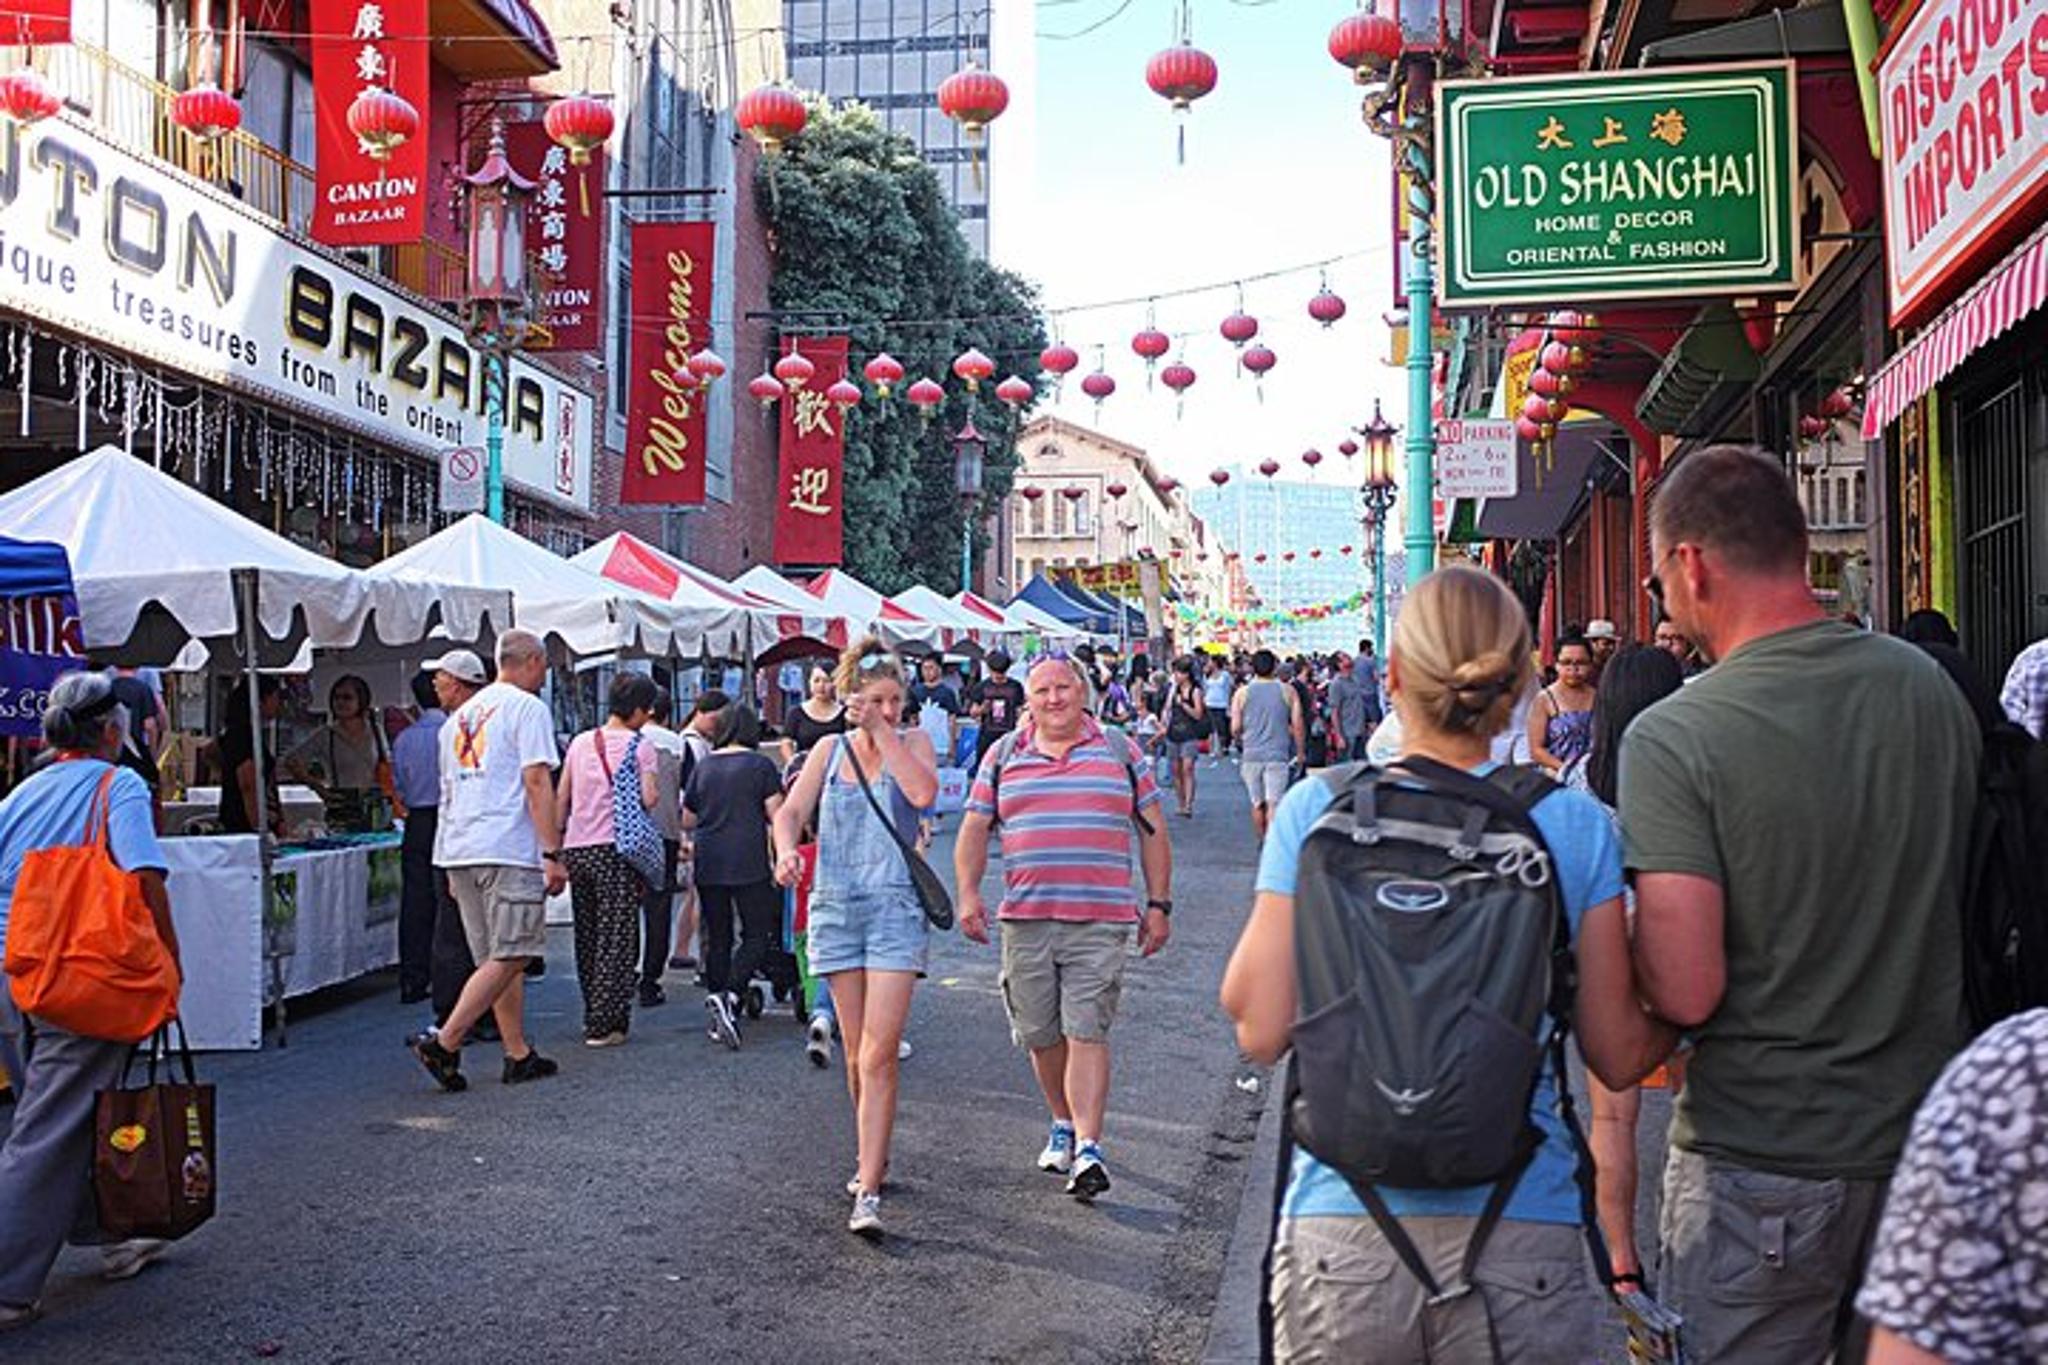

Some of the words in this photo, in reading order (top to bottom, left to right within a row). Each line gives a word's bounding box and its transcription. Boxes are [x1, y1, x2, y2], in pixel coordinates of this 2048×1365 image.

[1892, 0, 2031, 164] DISCOU
[1536, 108, 1688, 150] 大上海
[1905, 13, 2048, 250] IMPORTS
[328, 178, 417, 205] CANTON
[1474, 163, 1548, 209] OLD
[1560, 152, 1755, 205] SHANGHAI
[334, 206, 405, 225] BAZAAR
[1535, 213, 1601, 233] HOME
[1614, 210, 1695, 228] DECOR
[1606, 229, 1622, 245] &
[1507, 245, 1616, 265] ORIENTAL
[1629, 239, 1726, 259] FASHION
[110, 277, 258, 366] treasures
[280, 347, 337, 396] from
[356, 378, 389, 416] the
[406, 405, 462, 445] orient
[642, 249, 694, 477] Welcome
[788, 390, 835, 516] 歡迎
